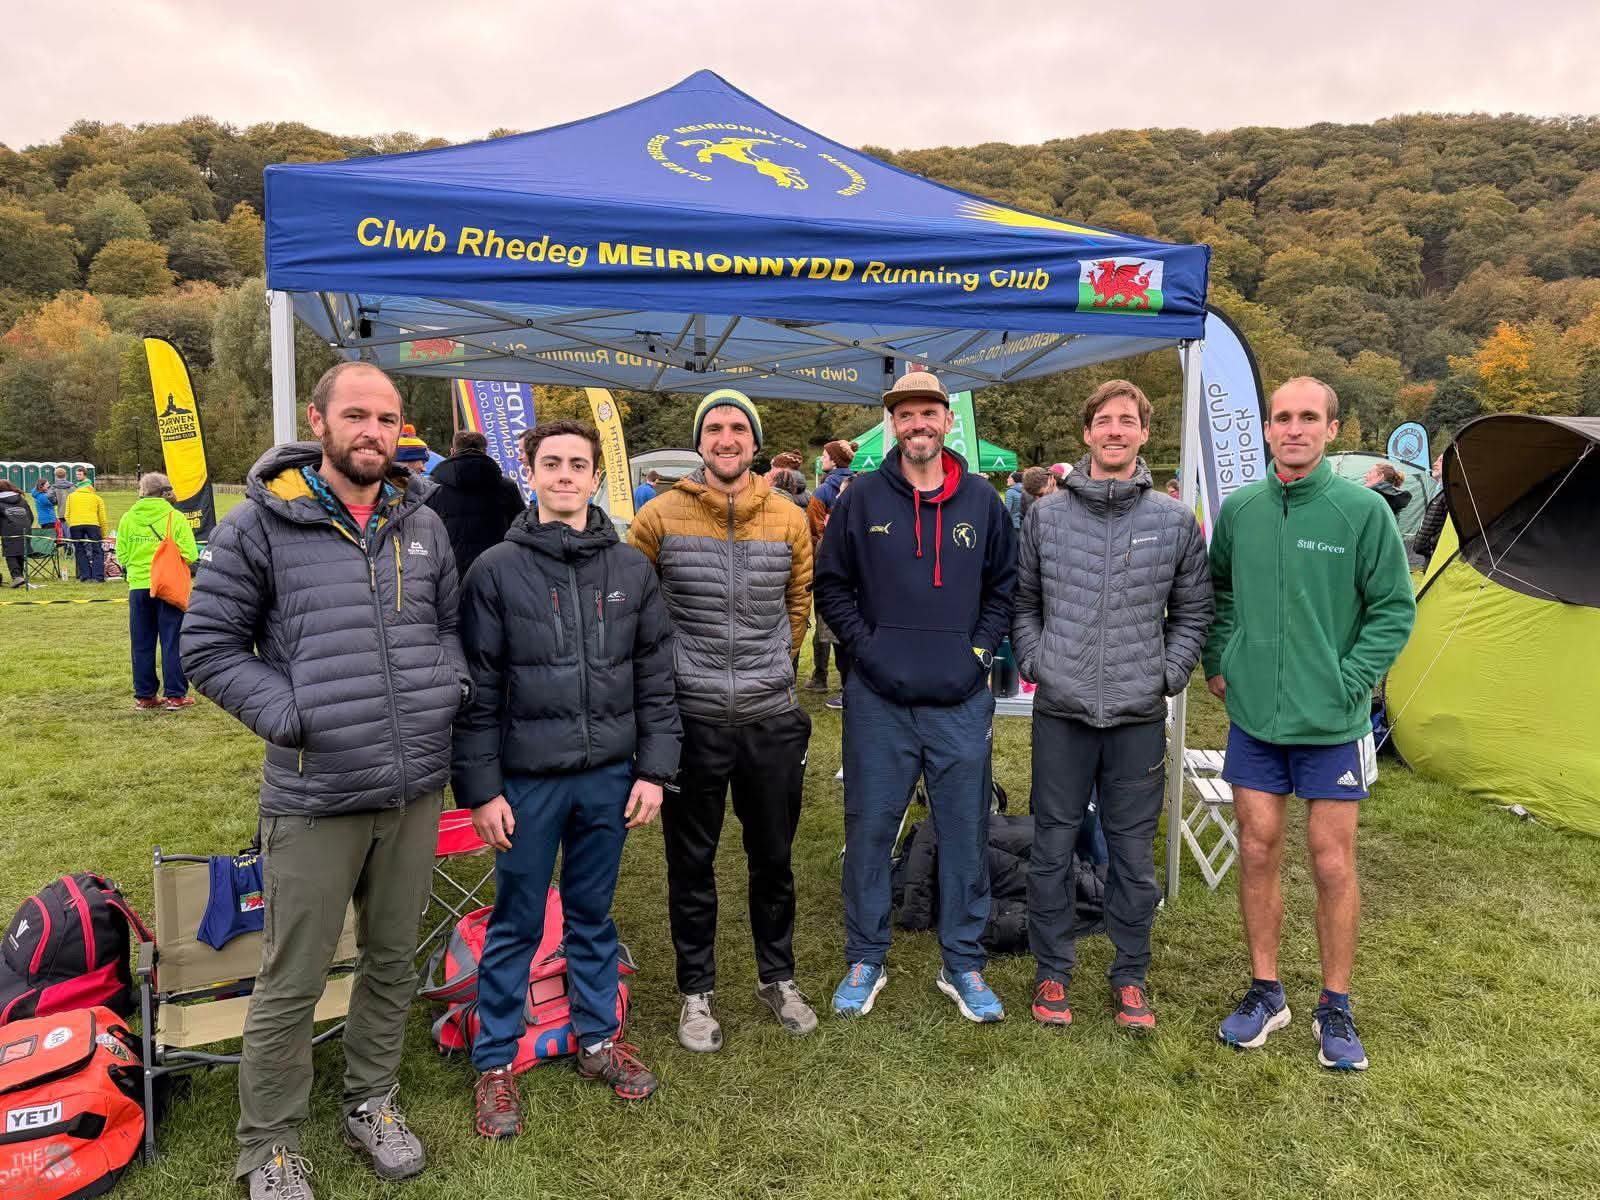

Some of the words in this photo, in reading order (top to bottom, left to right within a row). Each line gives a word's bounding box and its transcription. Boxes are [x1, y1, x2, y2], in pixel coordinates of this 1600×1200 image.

[673, 123, 807, 149] MEIRIONNYDD
[357, 217, 446, 252] Clwb
[457, 227, 588, 268] Rhedeg
[598, 242, 855, 282] MEIRIONNYDD
[861, 261, 979, 292] Running
[989, 268, 1049, 290] Club
[1297, 539, 1315, 550] Still
[1317, 542, 1344, 554] Green
[11, 1107, 58, 1127] YETI
[12, 1148, 43, 1168] THE
